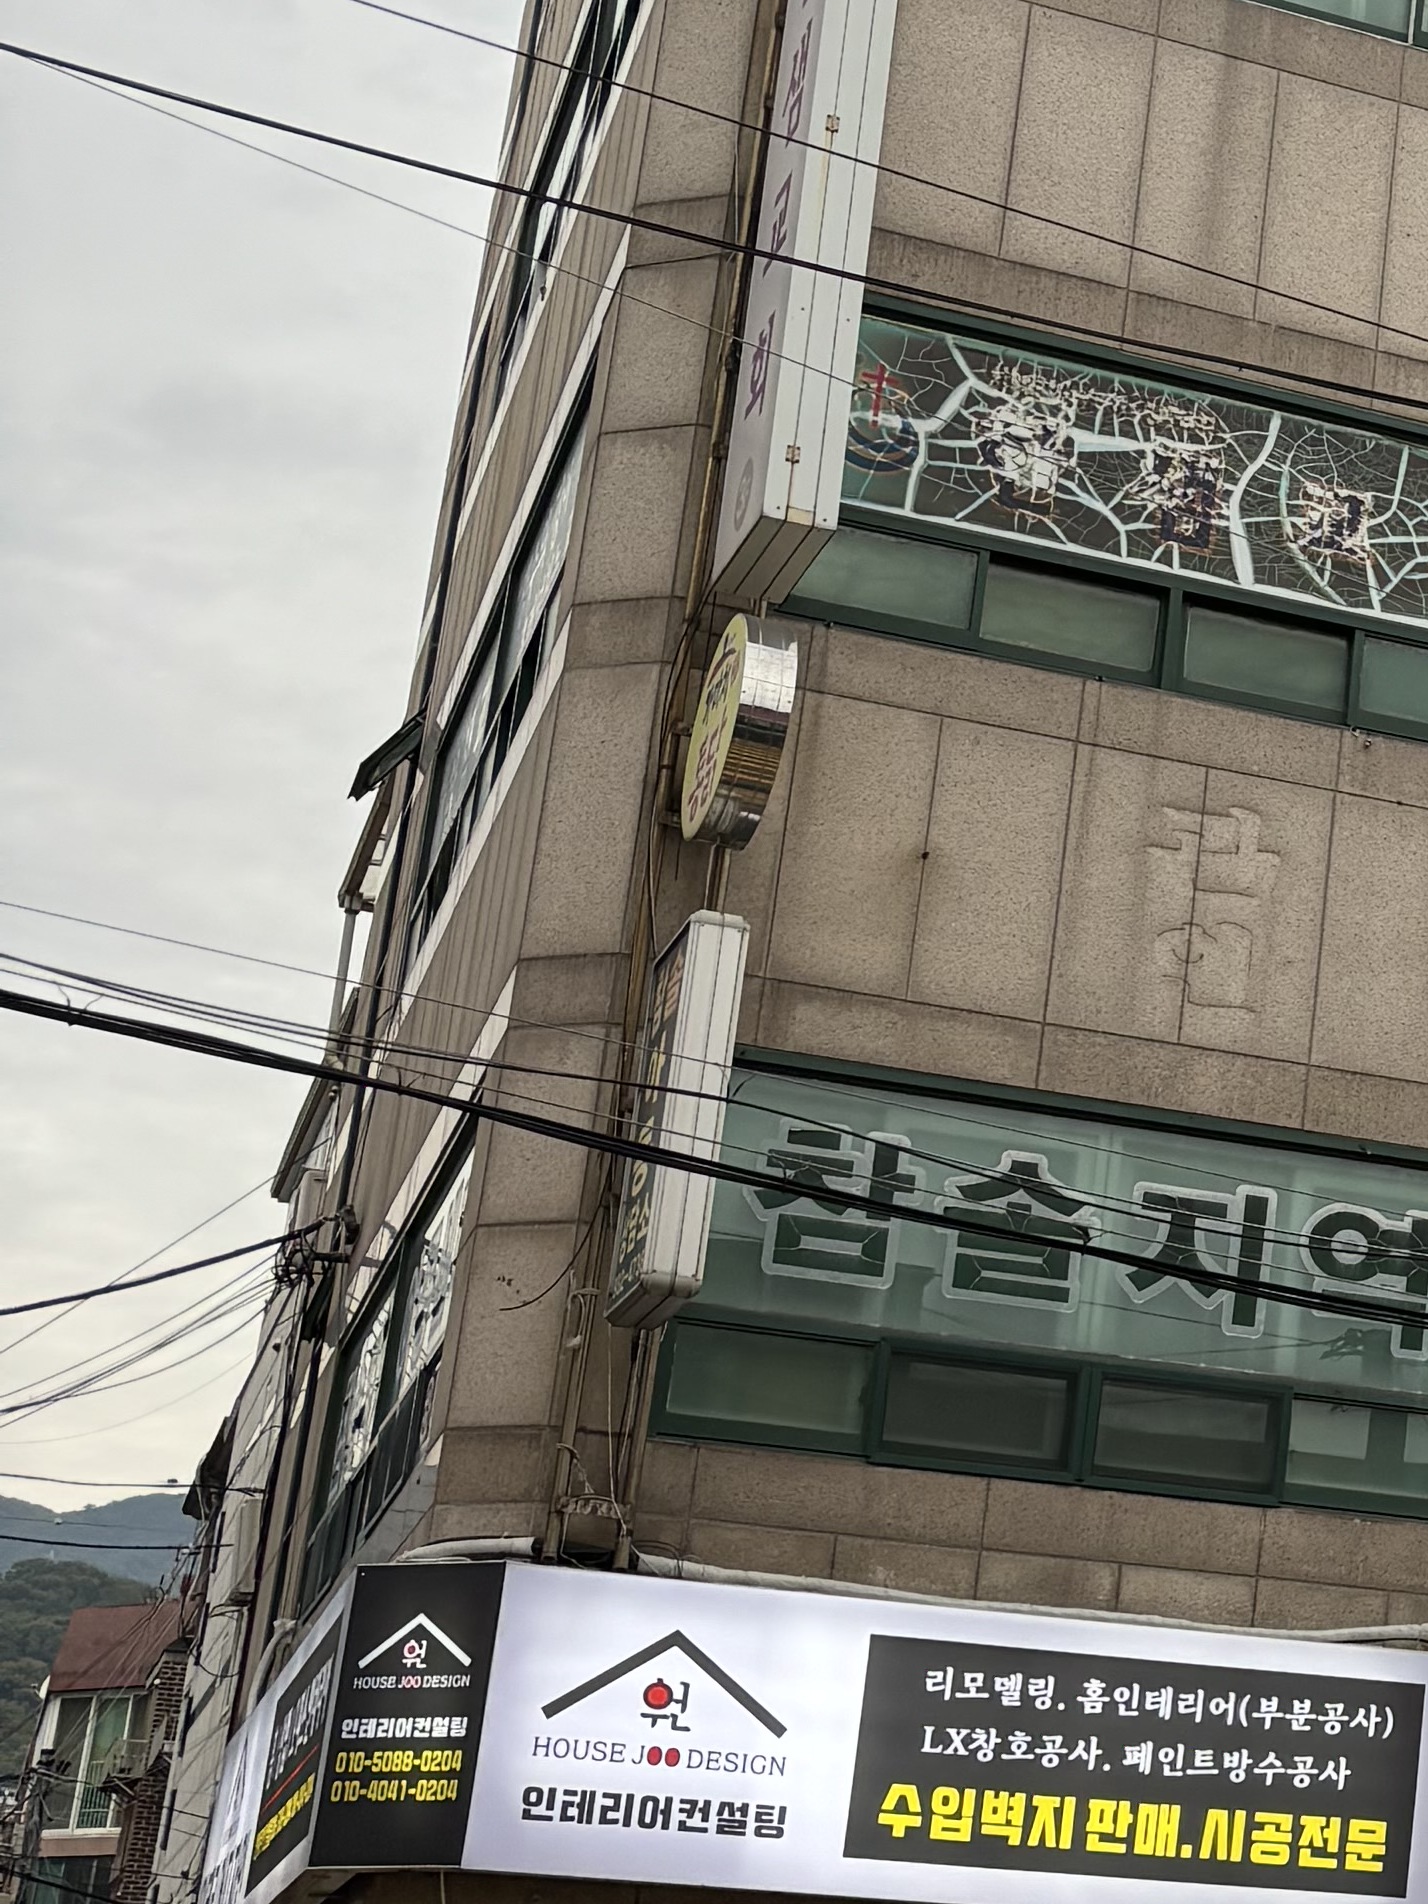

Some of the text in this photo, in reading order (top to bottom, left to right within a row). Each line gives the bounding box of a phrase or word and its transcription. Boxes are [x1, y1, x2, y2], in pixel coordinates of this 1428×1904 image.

[402, 1639, 428, 1669] 원
[353, 1675, 397, 1689] HOUSE
[422, 1674, 471, 1688] DESIGN
[641, 1676, 692, 1733] 원
[1075, 1677, 1395, 1741] 홈인테리어(부분공사)
[340, 1716, 469, 1739] 인테리어컨설팅
[335, 1748, 463, 1775] 010-5088-0204
[531, 1734, 626, 1764] HOUSE
[686, 1747, 788, 1778] DESIGN
[1122, 1740, 1352, 1792] 페인트방수공사
[329, 1778, 460, 1803] 010-4041-0204
[519, 1784, 788, 1840] 인테리어컨설팅
[876, 1782, 1389, 1874] 수입벽지 판매.시공전문
